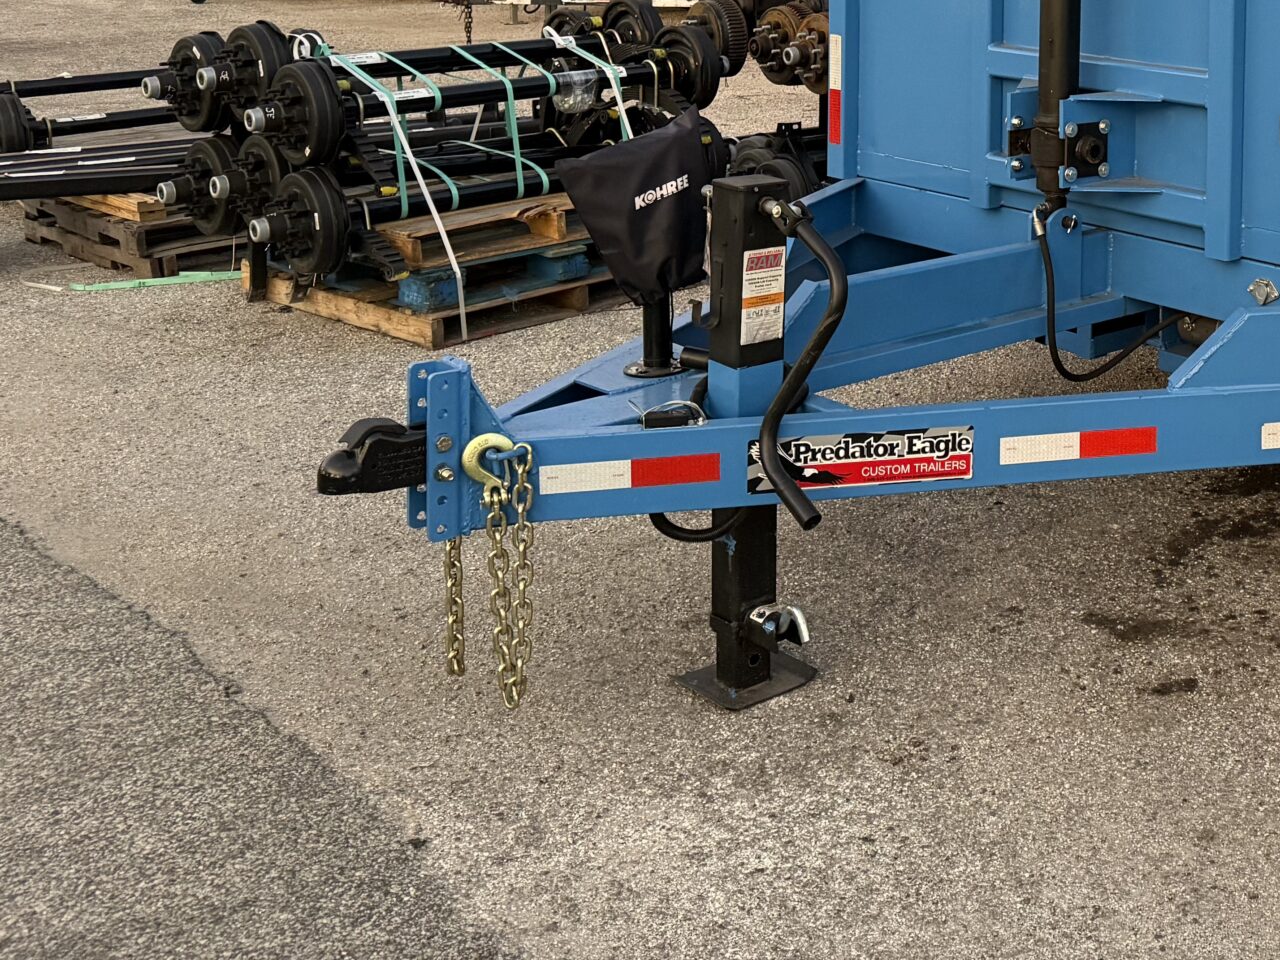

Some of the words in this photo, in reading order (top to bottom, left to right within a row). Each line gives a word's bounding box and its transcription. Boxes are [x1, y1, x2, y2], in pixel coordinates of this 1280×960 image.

[634, 173, 689, 210] KOHREE
[746, 254, 783, 271] RAM
[793, 438, 899, 464] Predator
[906, 432, 971, 459] Eagle
[861, 464, 911, 477] CUSTOM
[914, 460, 967, 473] TRAILERS
